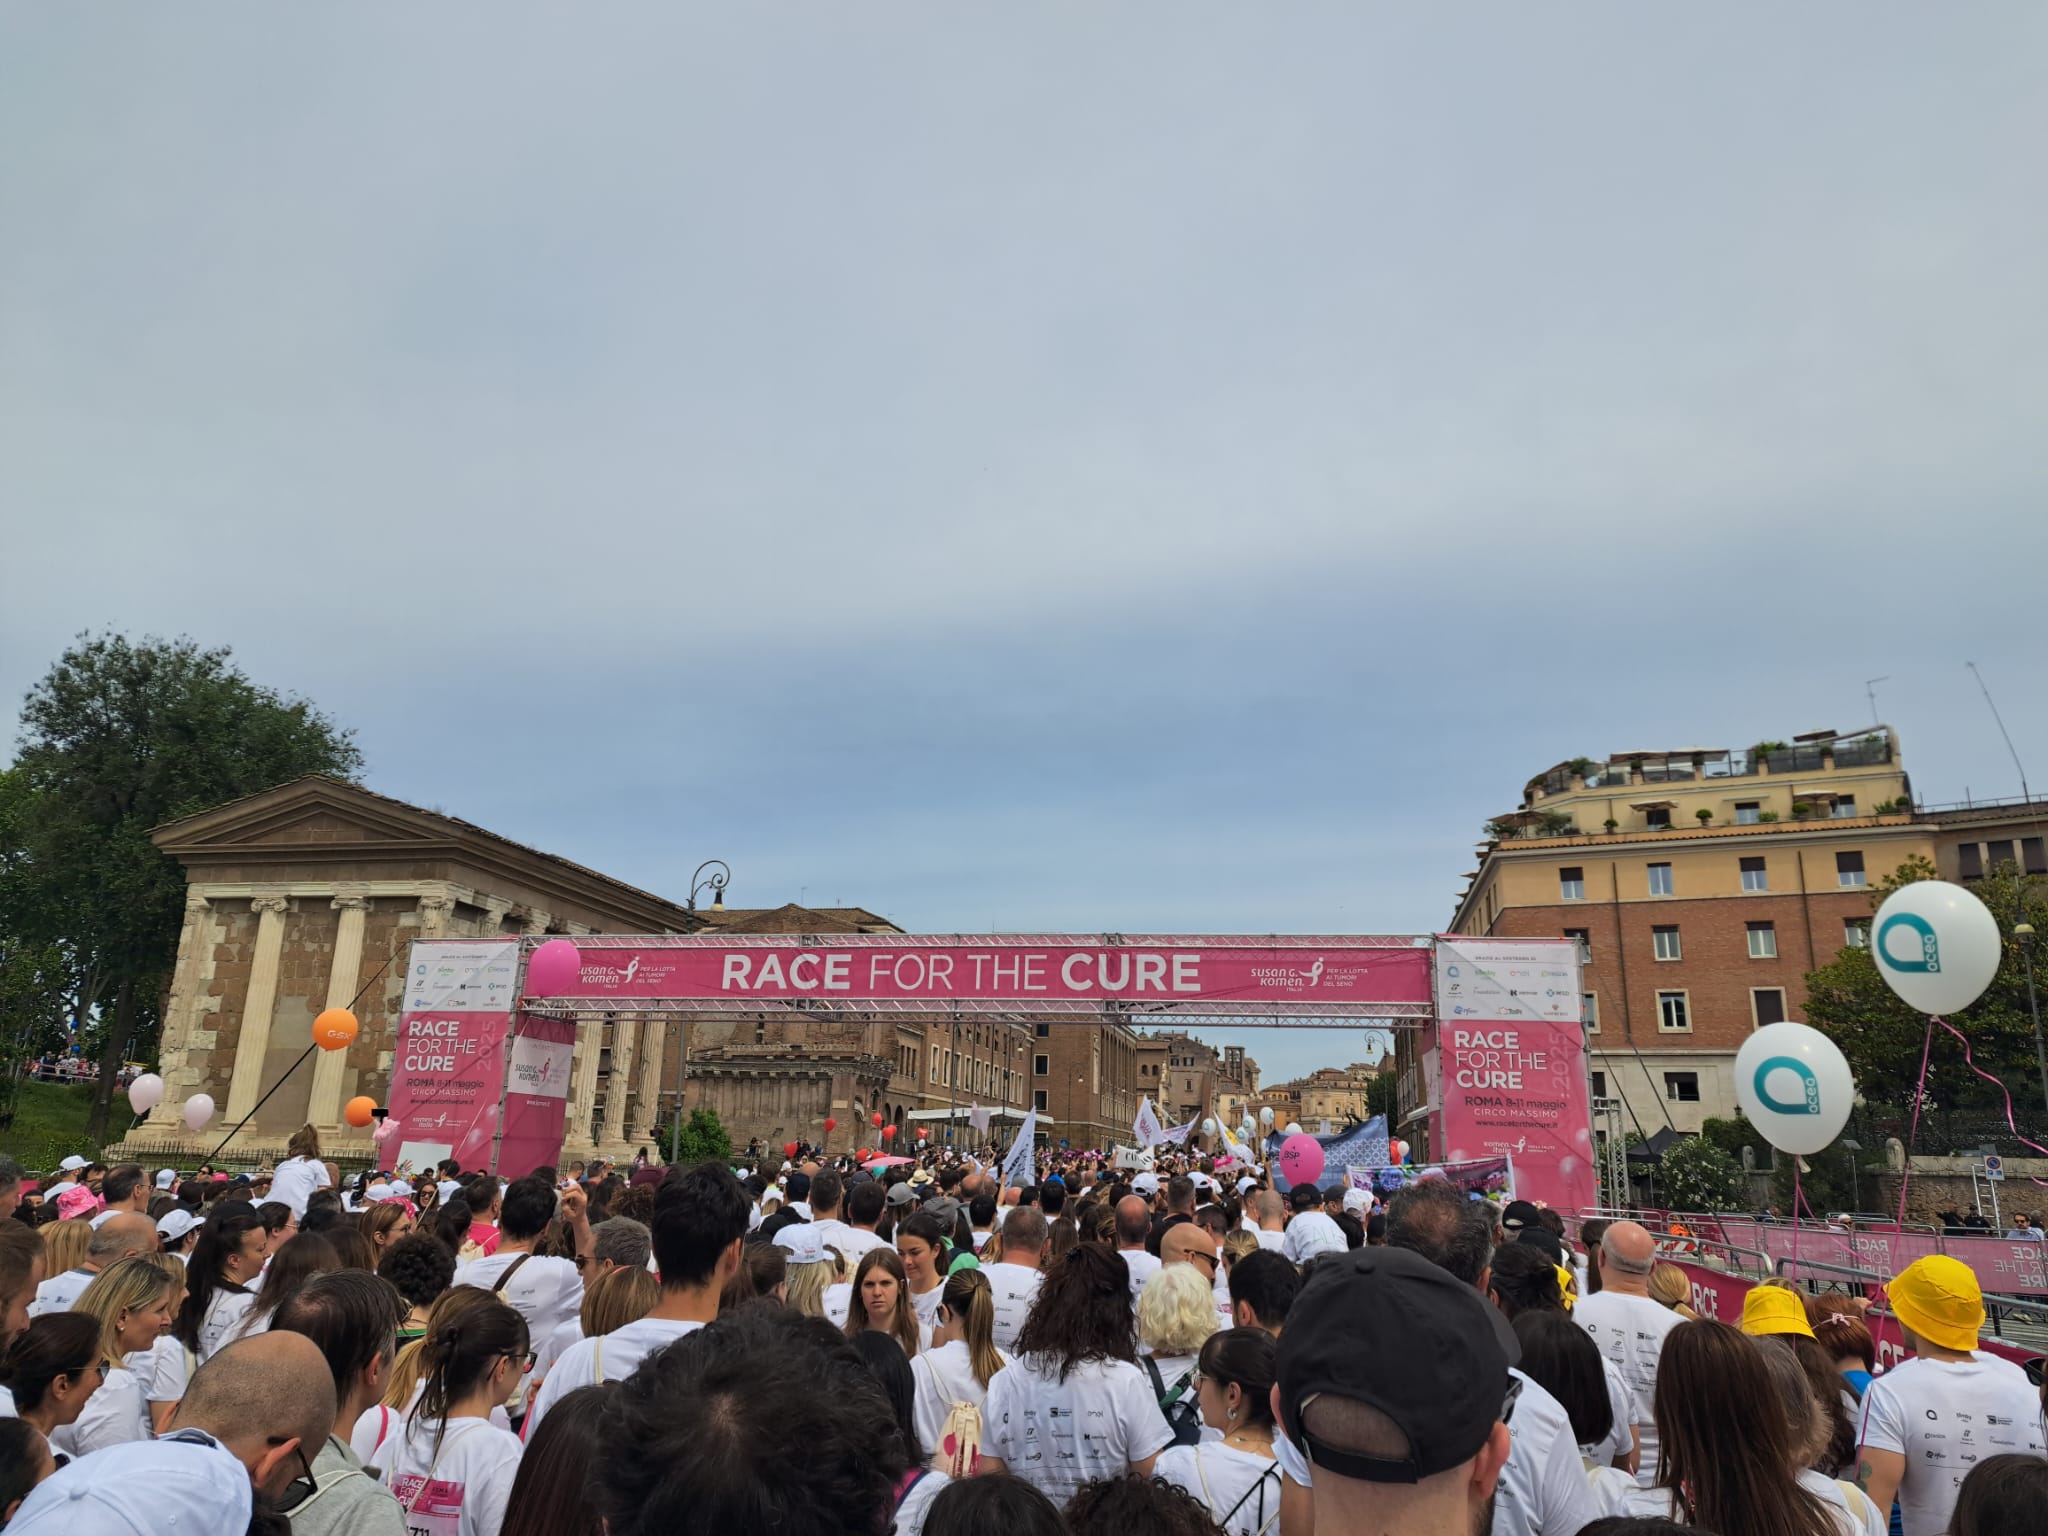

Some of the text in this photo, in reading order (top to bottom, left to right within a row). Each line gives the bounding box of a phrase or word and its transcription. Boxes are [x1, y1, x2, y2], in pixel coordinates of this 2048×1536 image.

[1924, 934, 1938, 972] acea
[722, 953, 1201, 991] RACE FOR THE CURE
[409, 1020, 460, 1037] RACE
[407, 1038, 478, 1054] FOR THE
[477, 1020, 497, 1071] 2025
[1454, 1030, 1520, 1049] RACE
[405, 1055, 456, 1072] CURE
[1455, 1050, 1548, 1070] FOR THE
[1549, 1032, 1570, 1089] 2025
[406, 1079, 435, 1087] ROMA
[452, 1080, 485, 1090] maggio
[1456, 1069, 1523, 1089] CURE
[411, 1088, 477, 1096] CIRCO MASSIMO
[1806, 1078, 1818, 1113] acea
[1464, 1096, 1567, 1110] ROMA 8-11 maggio
[1473, 1108, 1559, 1118] CIRCO MASSIMO
[401, 1478, 424, 1489] RACE
[407, 1526, 429, 1536] 711
